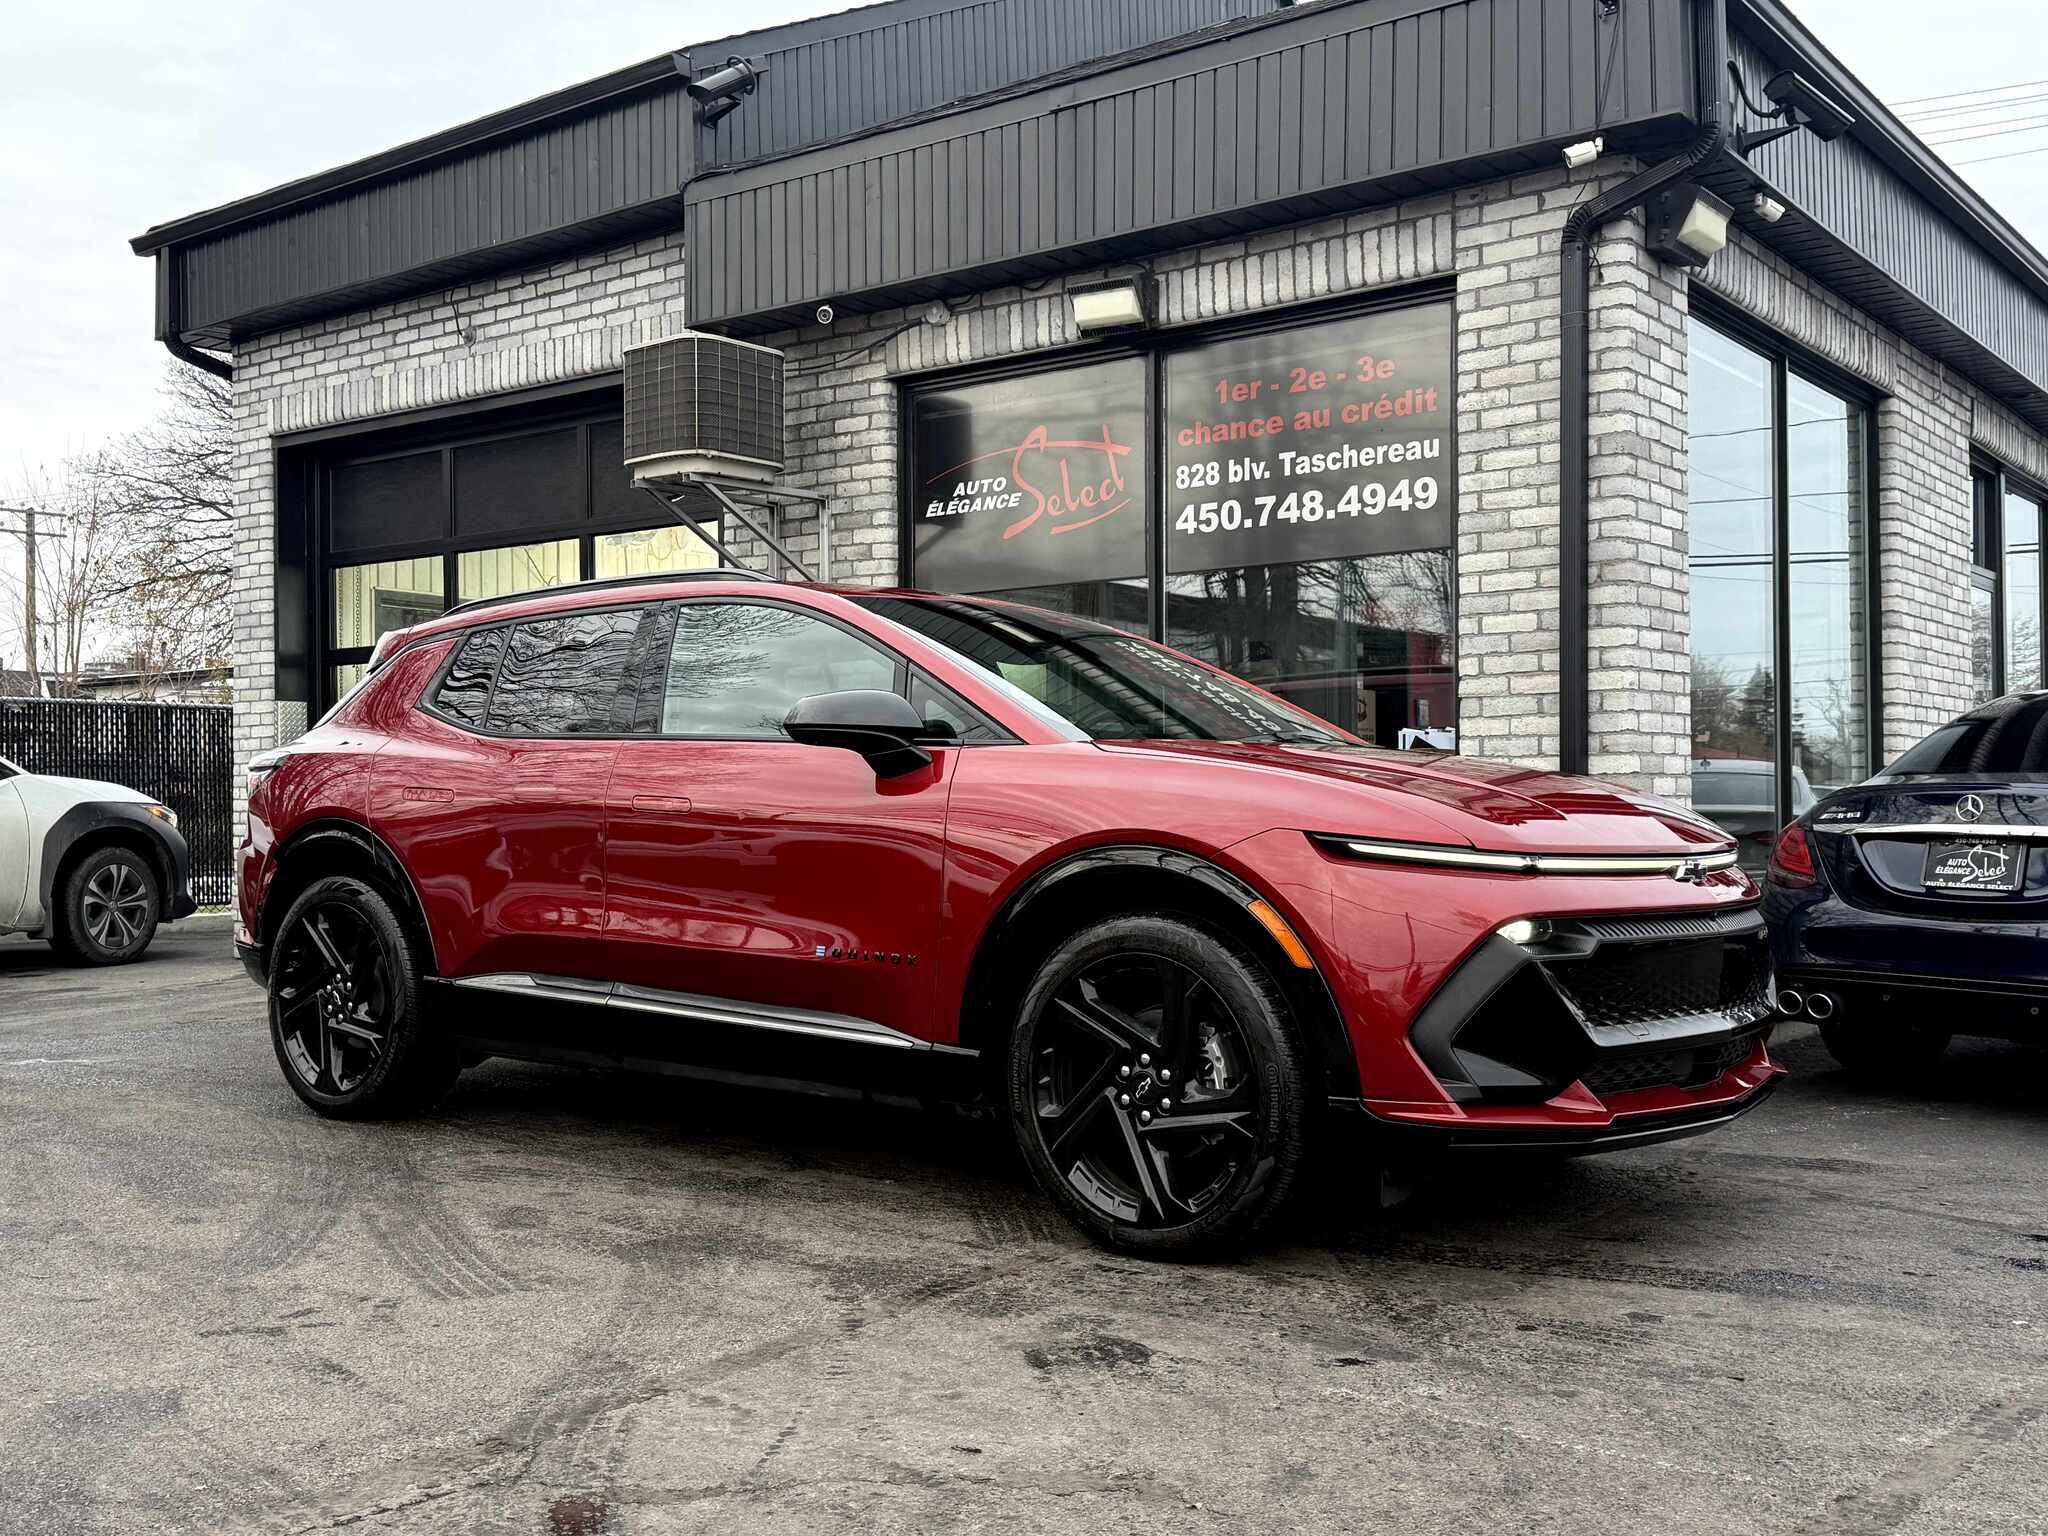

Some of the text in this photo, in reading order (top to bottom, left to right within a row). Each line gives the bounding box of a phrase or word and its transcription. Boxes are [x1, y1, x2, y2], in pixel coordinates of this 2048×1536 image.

[1215, 379, 1262, 404] 1er
[1289, 367, 1326, 394] 2e
[1357, 356, 1395, 382] 3e
[1177, 385, 1438, 447] chance au crédit
[1002, 424, 1132, 540] Select
[1175, 438, 1440, 490] 828 blv. Taschereau
[925, 492, 1022, 518] ÉLÉGANCE
[952, 476, 1007, 497] AUTO
[1175, 476, 1438, 535] 450.748.4949
[1946, 858, 1968, 867] AUTO
[1961, 844, 2010, 883] Select
[1987, 883, 2014, 891] SELECT
[815, 944, 919, 967] EQUINOX
